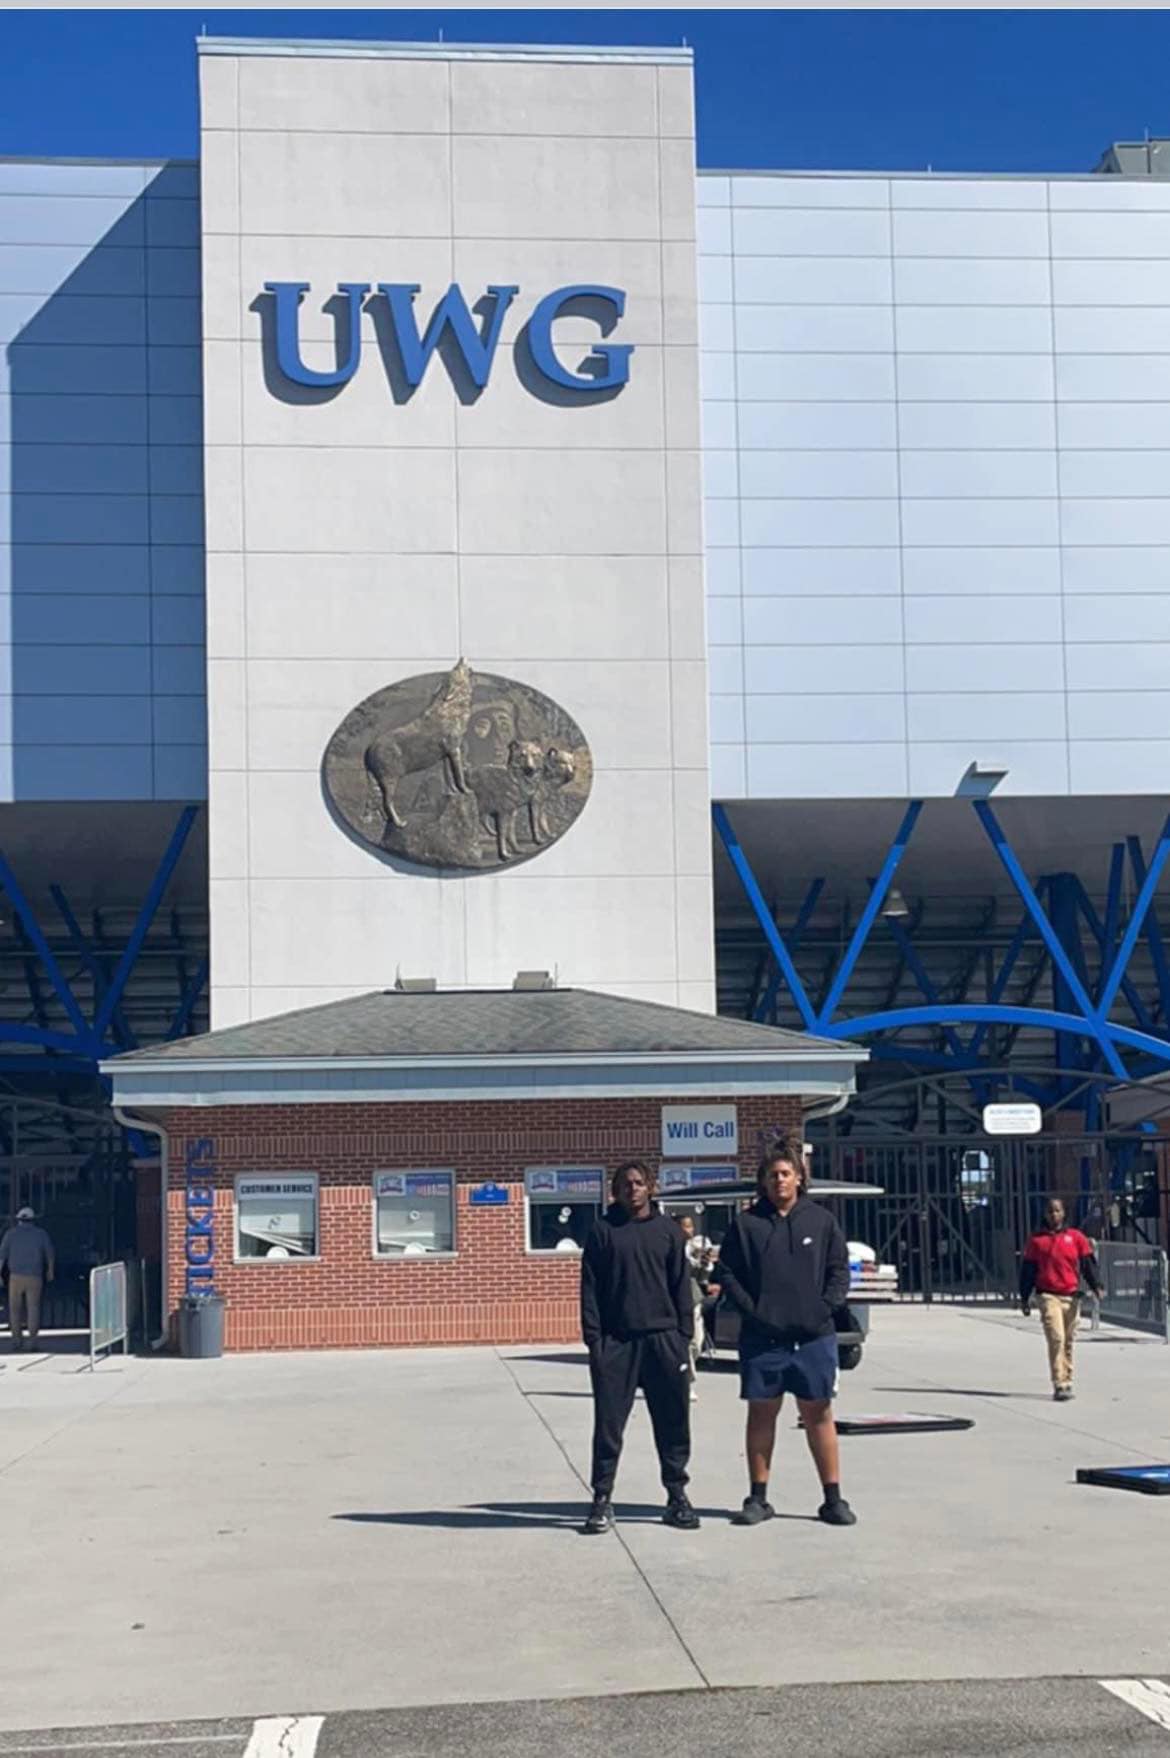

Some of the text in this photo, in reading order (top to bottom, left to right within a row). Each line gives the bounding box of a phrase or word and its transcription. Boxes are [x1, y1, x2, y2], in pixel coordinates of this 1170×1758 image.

[263, 281, 635, 390] UWG
[666, 1121, 734, 1138] Will Call
[186, 1136, 215, 1298] TICKETS
[240, 1183, 313, 1195] CUSTOMER SERVICE
